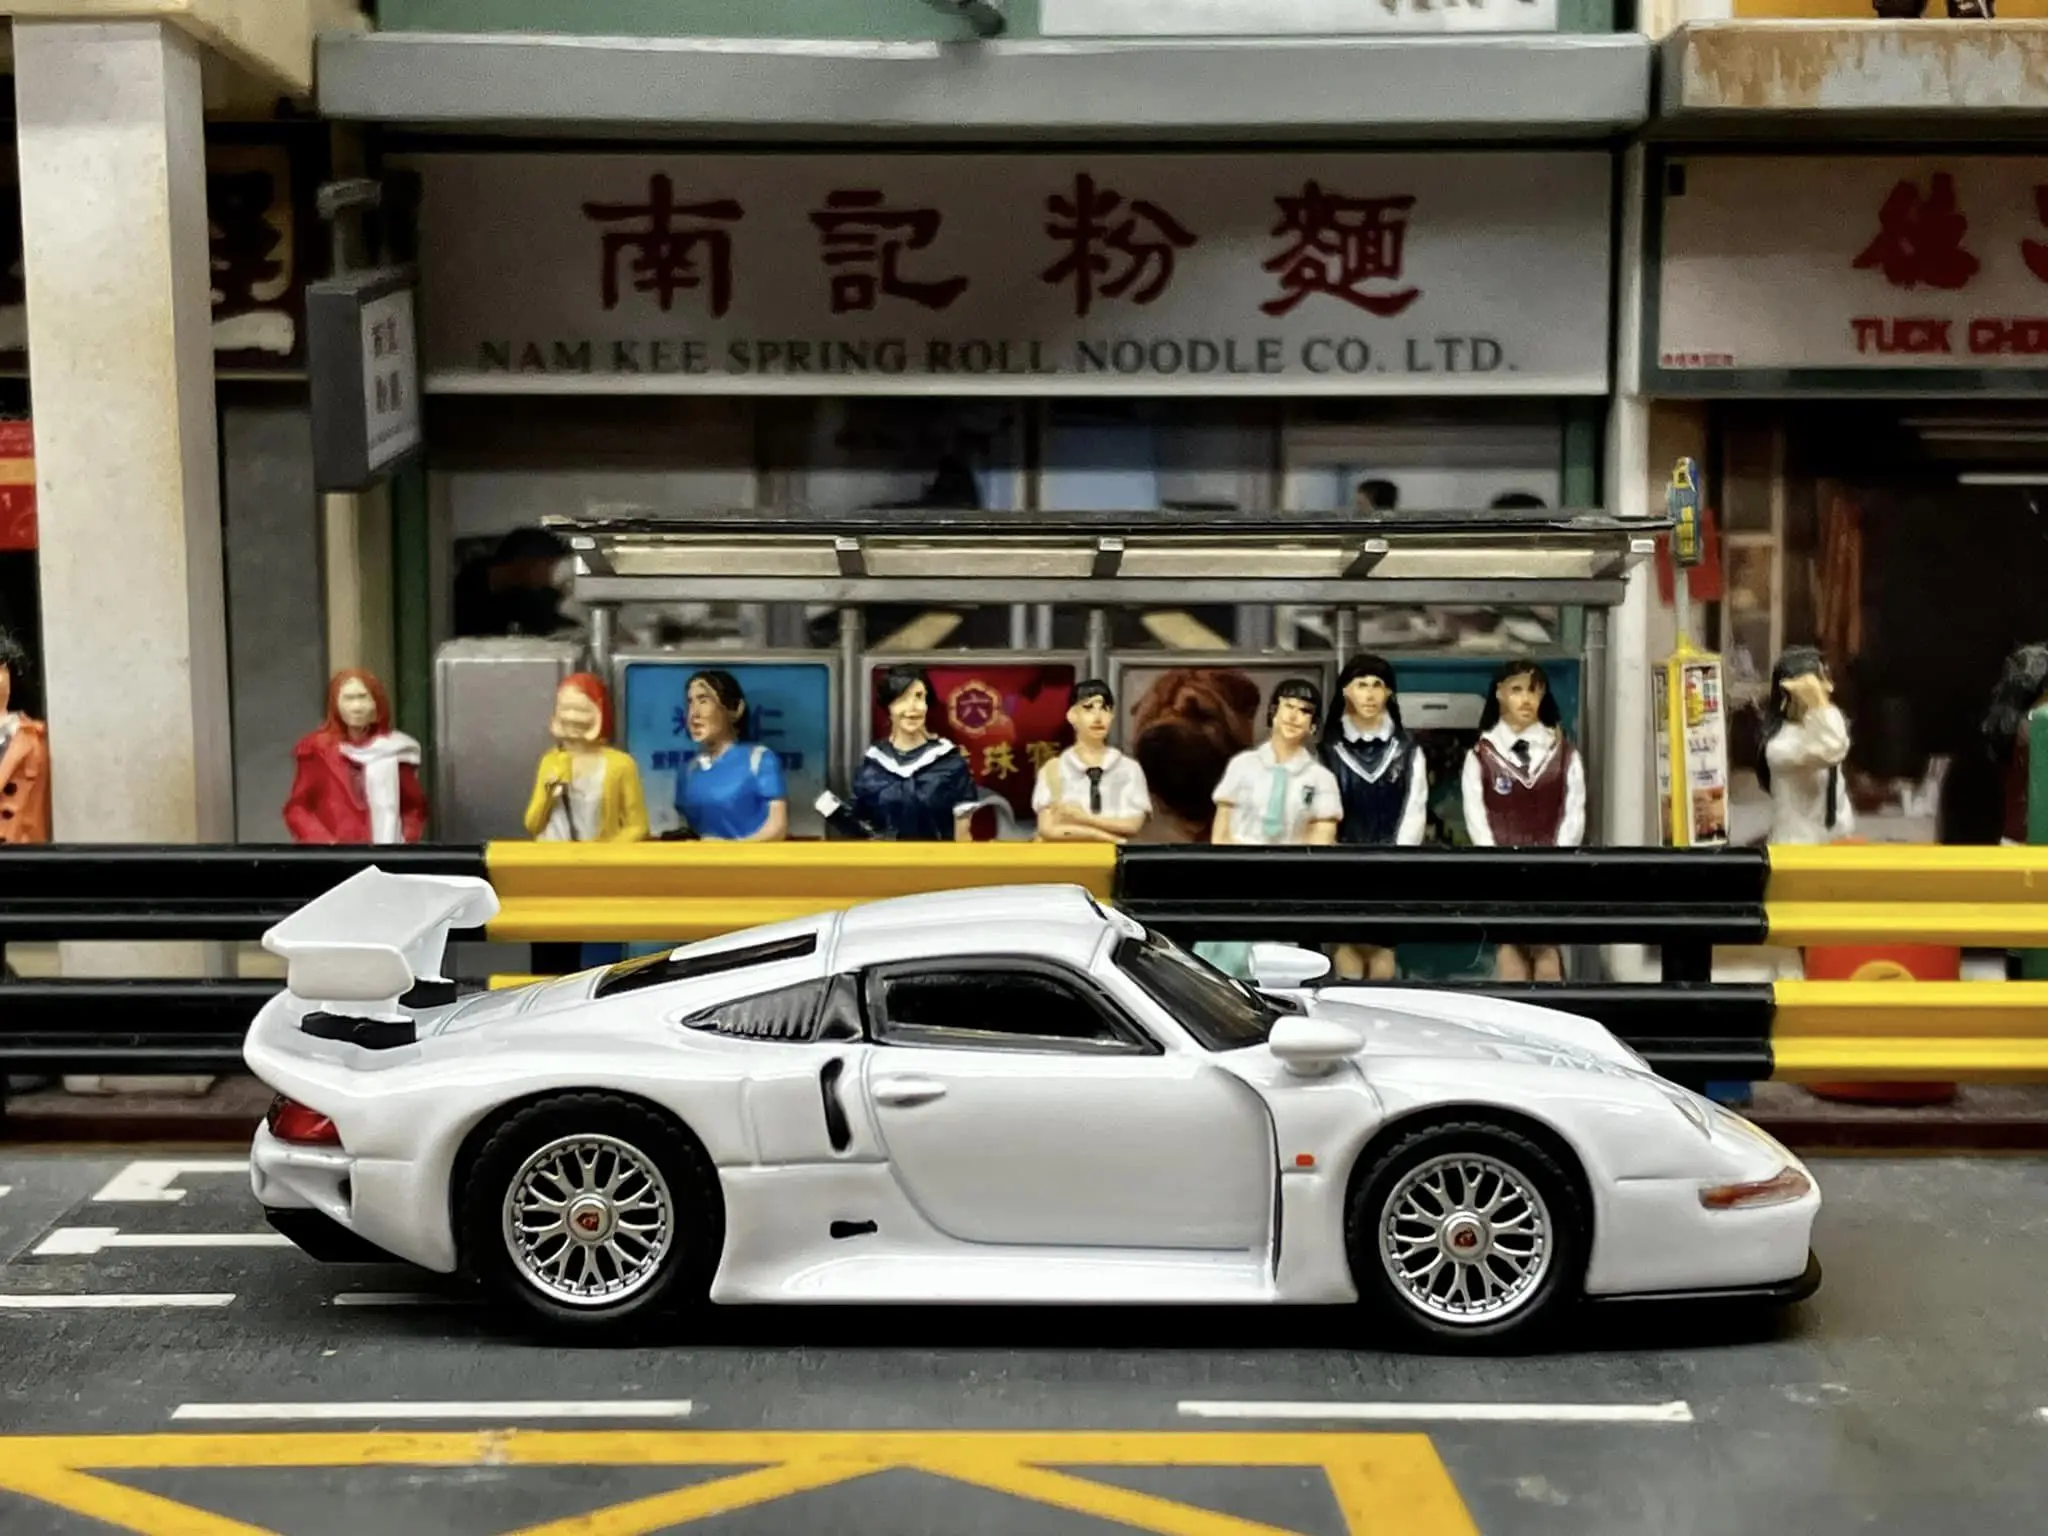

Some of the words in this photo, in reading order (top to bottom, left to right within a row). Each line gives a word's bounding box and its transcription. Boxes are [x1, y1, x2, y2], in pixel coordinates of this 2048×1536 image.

[1850, 317, 1952, 354] TUCK
[478, 339, 592, 374] NAM
[612, 339, 711, 374] KEE
[726, 339, 906, 374] SPRING
[925, 339, 1056, 374] ROLL
[1076, 338, 1284, 374] NOODLE
[1301, 338, 1386, 373] CO.
[1406, 337, 1519, 373] LTD.
